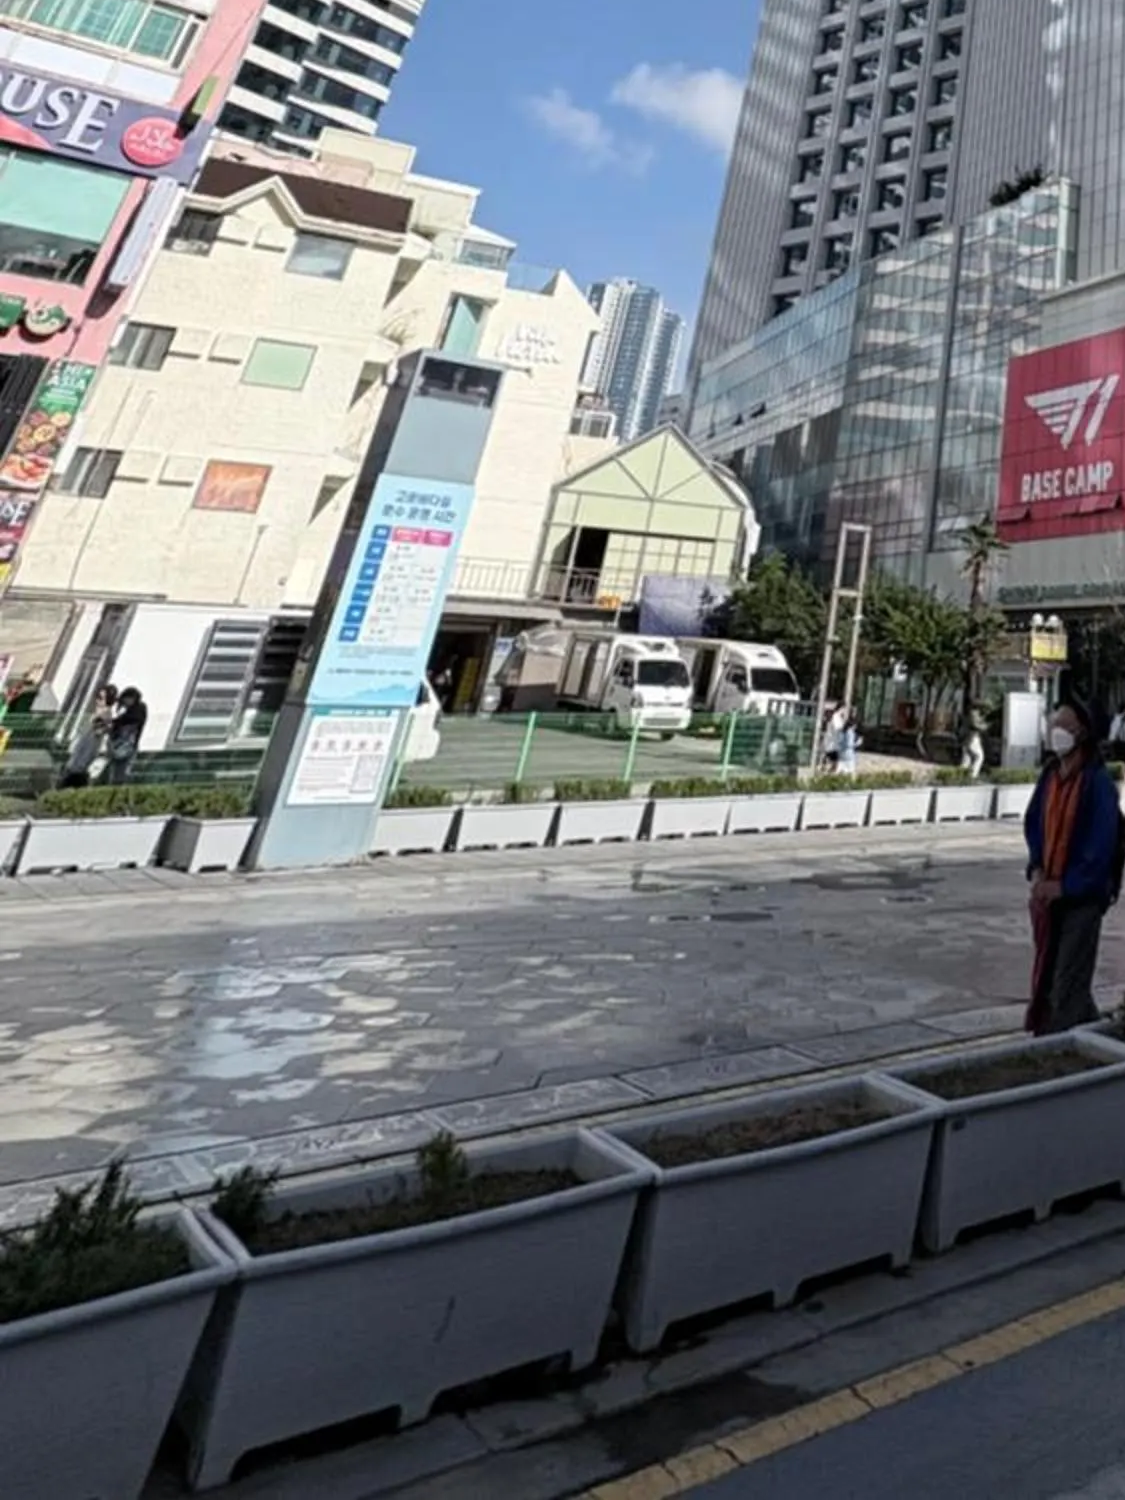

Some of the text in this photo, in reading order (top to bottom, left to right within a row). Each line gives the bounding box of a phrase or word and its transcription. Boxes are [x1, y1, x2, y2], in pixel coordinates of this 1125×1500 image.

[0, 69, 121, 153] USE
[1020, 460, 1114, 503] BASE CAMP
